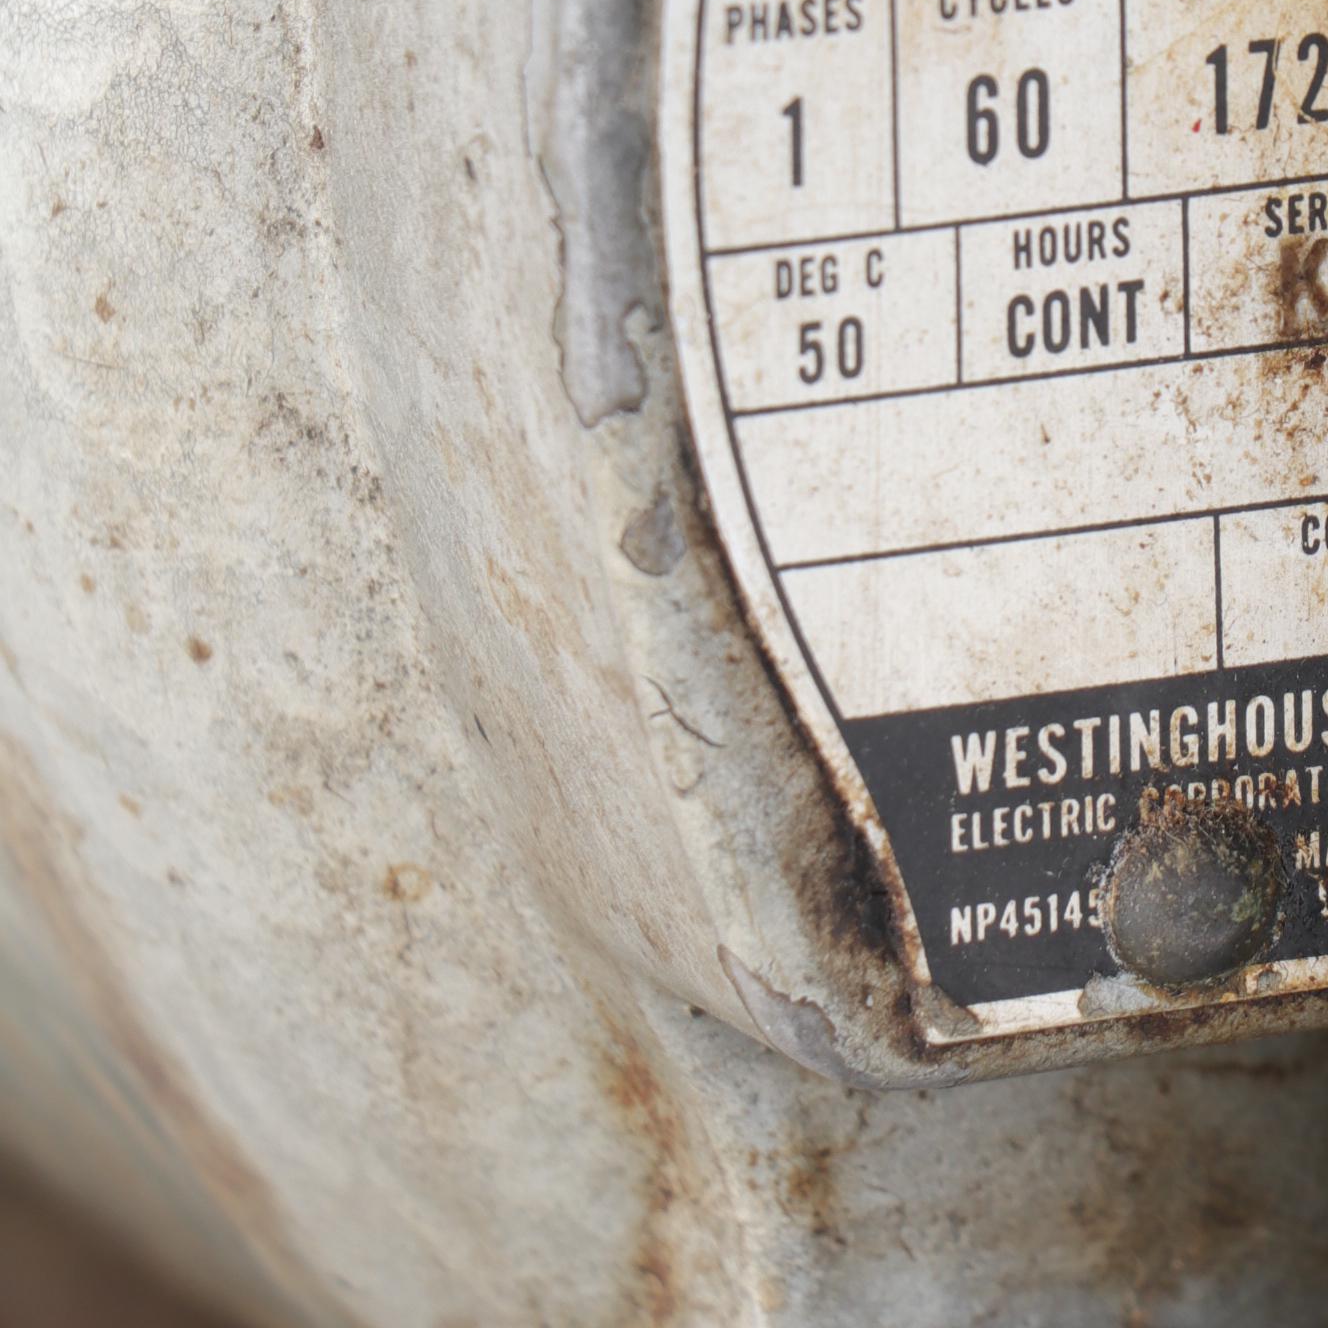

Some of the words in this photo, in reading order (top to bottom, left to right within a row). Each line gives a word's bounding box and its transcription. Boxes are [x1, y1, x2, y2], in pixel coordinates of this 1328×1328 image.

[781, 96, 804, 188] 1
[965, 67, 1051, 166] 60
[774, 258, 837, 299] DEG
[866, 250, 884, 289] C
[1011, 217, 1132, 271] HOURS
[797, 316, 865, 385] 50
[1006, 279, 1145, 359] CONT
[950, 793, 1117, 854] ELECTRIC
